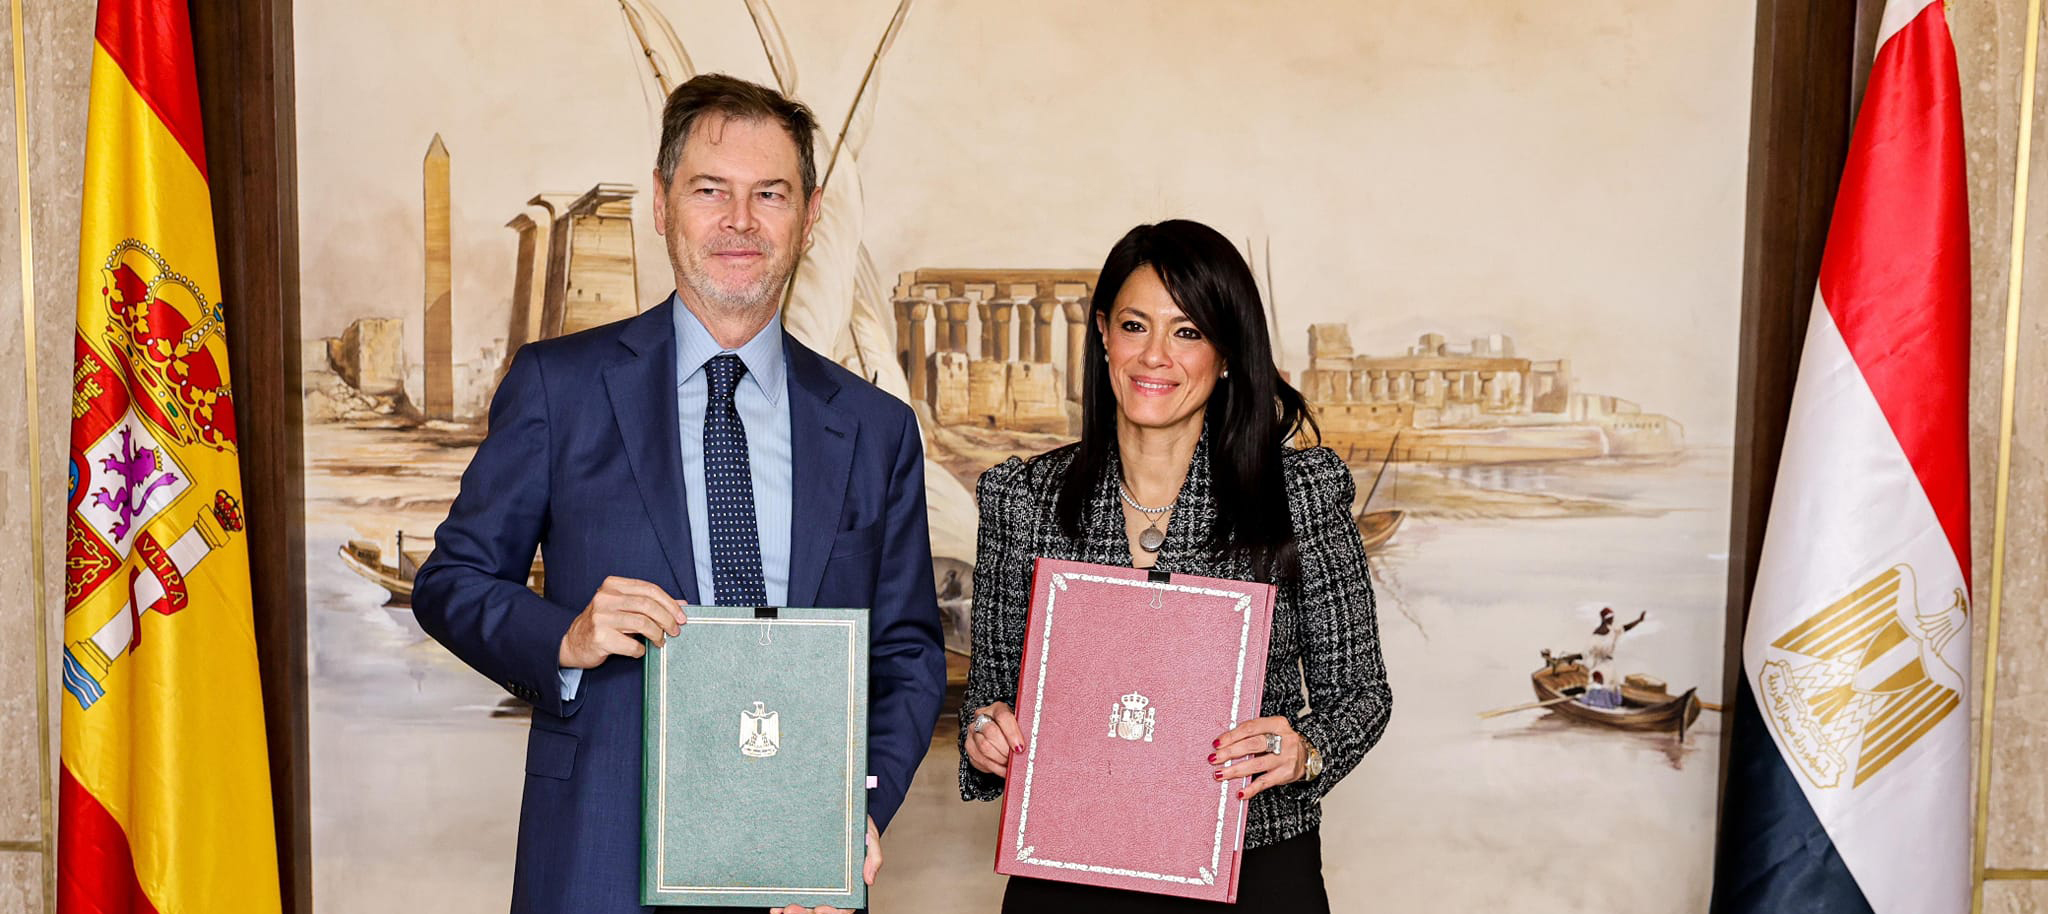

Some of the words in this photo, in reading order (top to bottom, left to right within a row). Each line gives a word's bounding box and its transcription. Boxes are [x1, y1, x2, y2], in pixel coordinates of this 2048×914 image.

[143, 538, 185, 605] VLTRA
[1768, 672, 1790, 713] العربية
[1777, 713, 1796, 736] مصر
[1793, 733, 1830, 778] جمهورية
